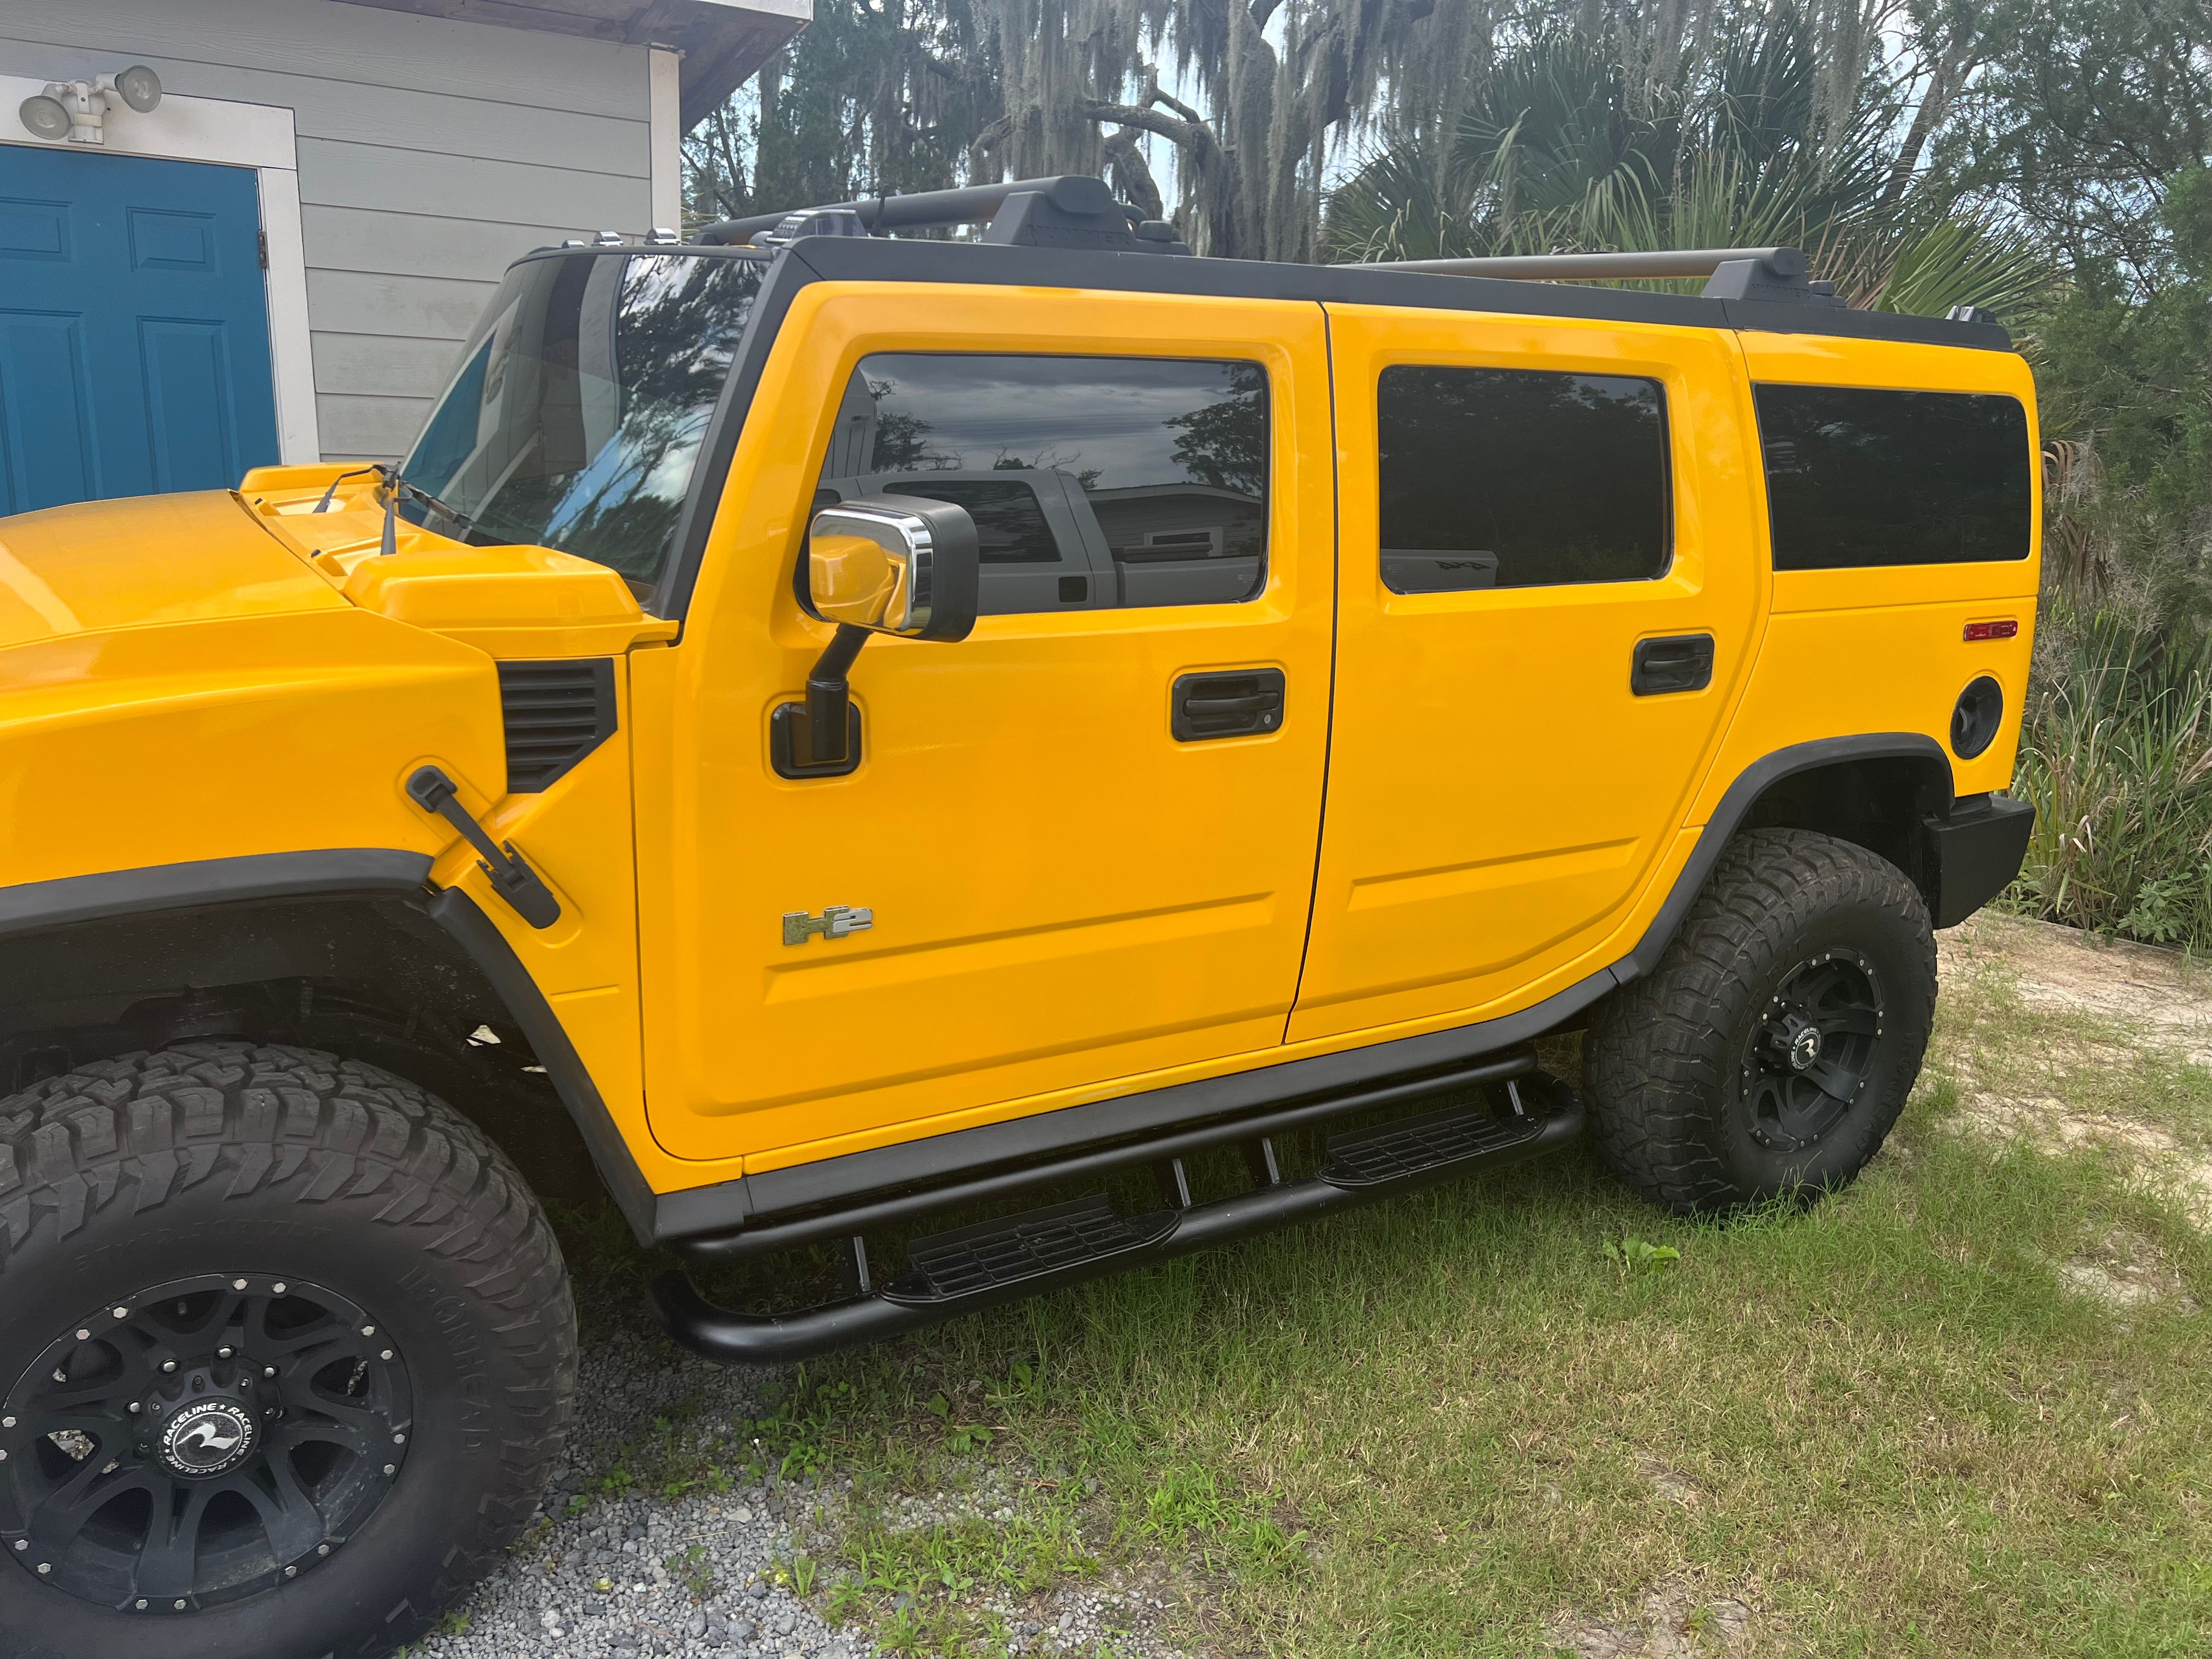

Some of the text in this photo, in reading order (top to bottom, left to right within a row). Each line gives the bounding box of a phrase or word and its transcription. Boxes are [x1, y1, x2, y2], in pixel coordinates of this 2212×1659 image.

[1026, 224, 1130, 246] HUMMER
[783, 905, 873, 945] H2
[1795, 1027, 1817, 1046] RACELINE
[397, 1264, 492, 1453] IRONHEAD
[163, 1402, 217, 1446] RACELINE
[227, 1406, 252, 1457] RACELINE
[166, 1455, 227, 1475] RACELINE
